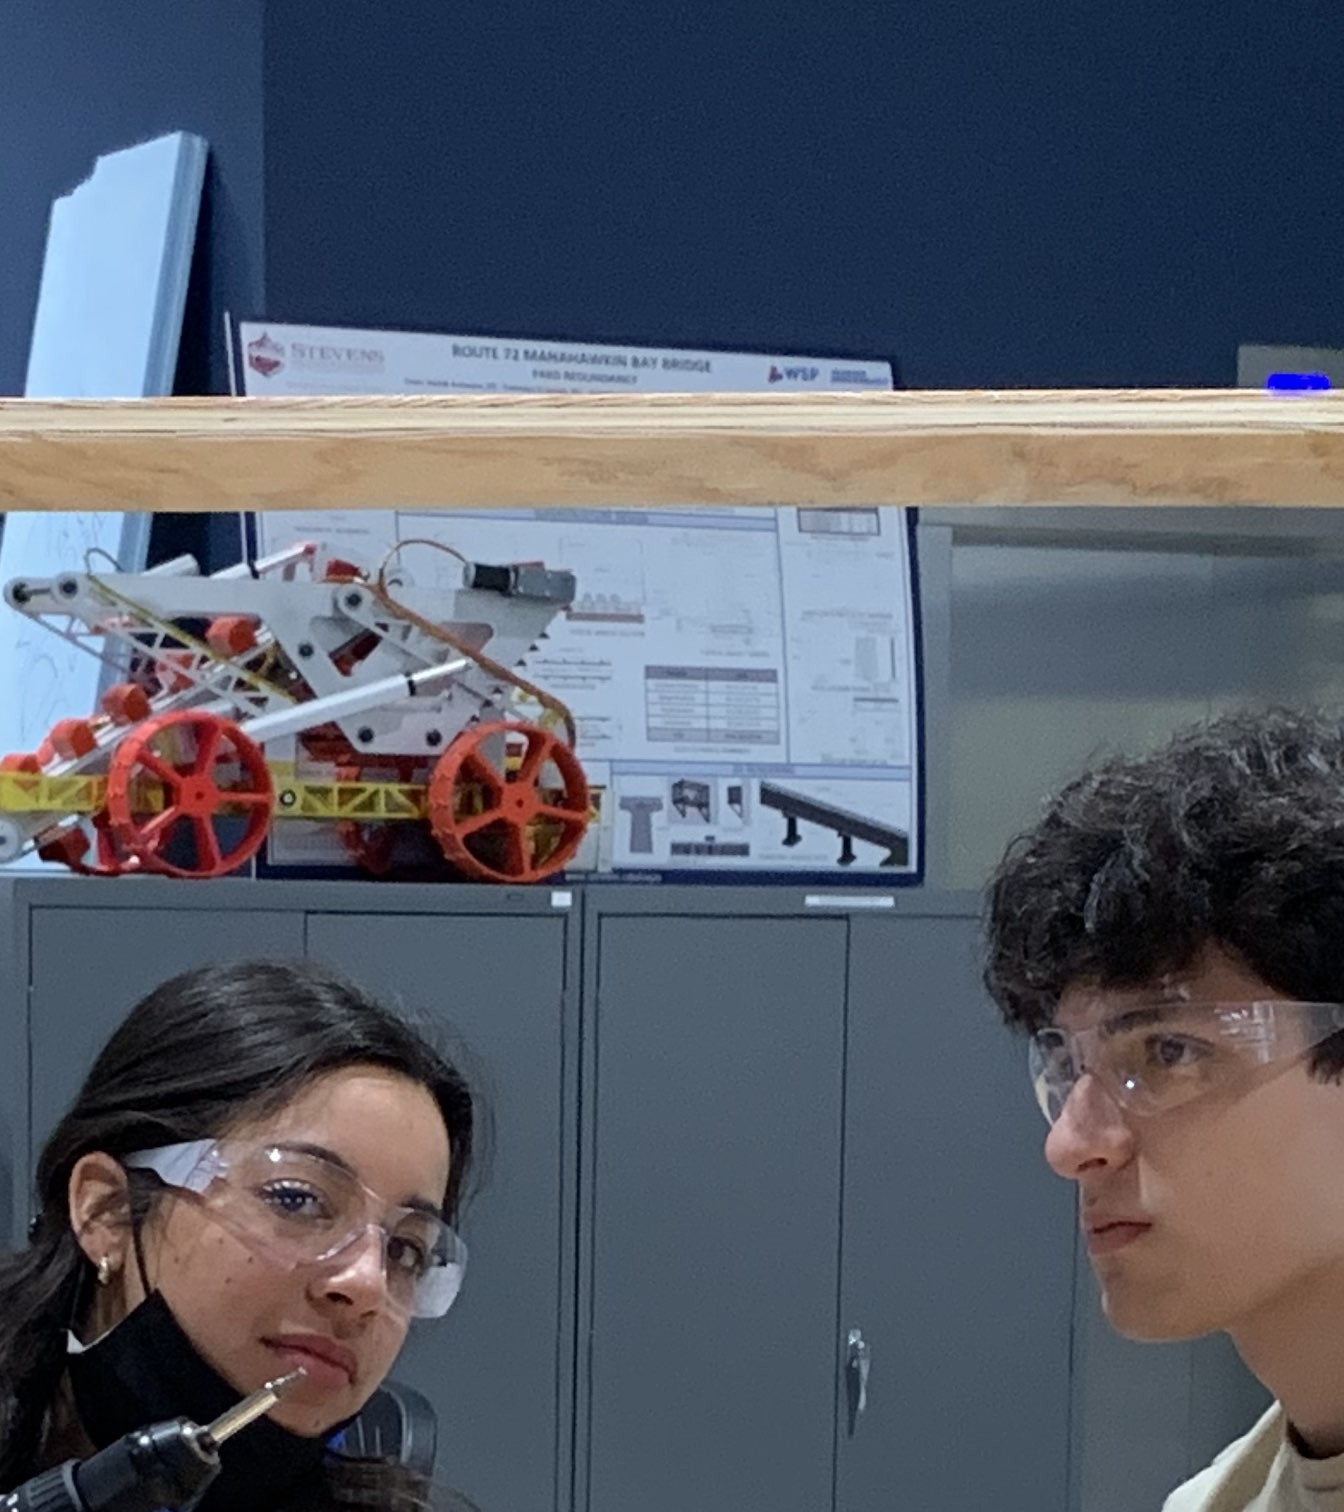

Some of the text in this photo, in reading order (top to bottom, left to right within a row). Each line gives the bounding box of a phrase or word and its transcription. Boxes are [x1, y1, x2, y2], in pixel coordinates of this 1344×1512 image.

[452, 344, 498, 361] ROUTE
[632, 354, 658, 369] BAY
[662, 356, 712, 373] BRIDGE
[784, 366, 820, 382] WSP
